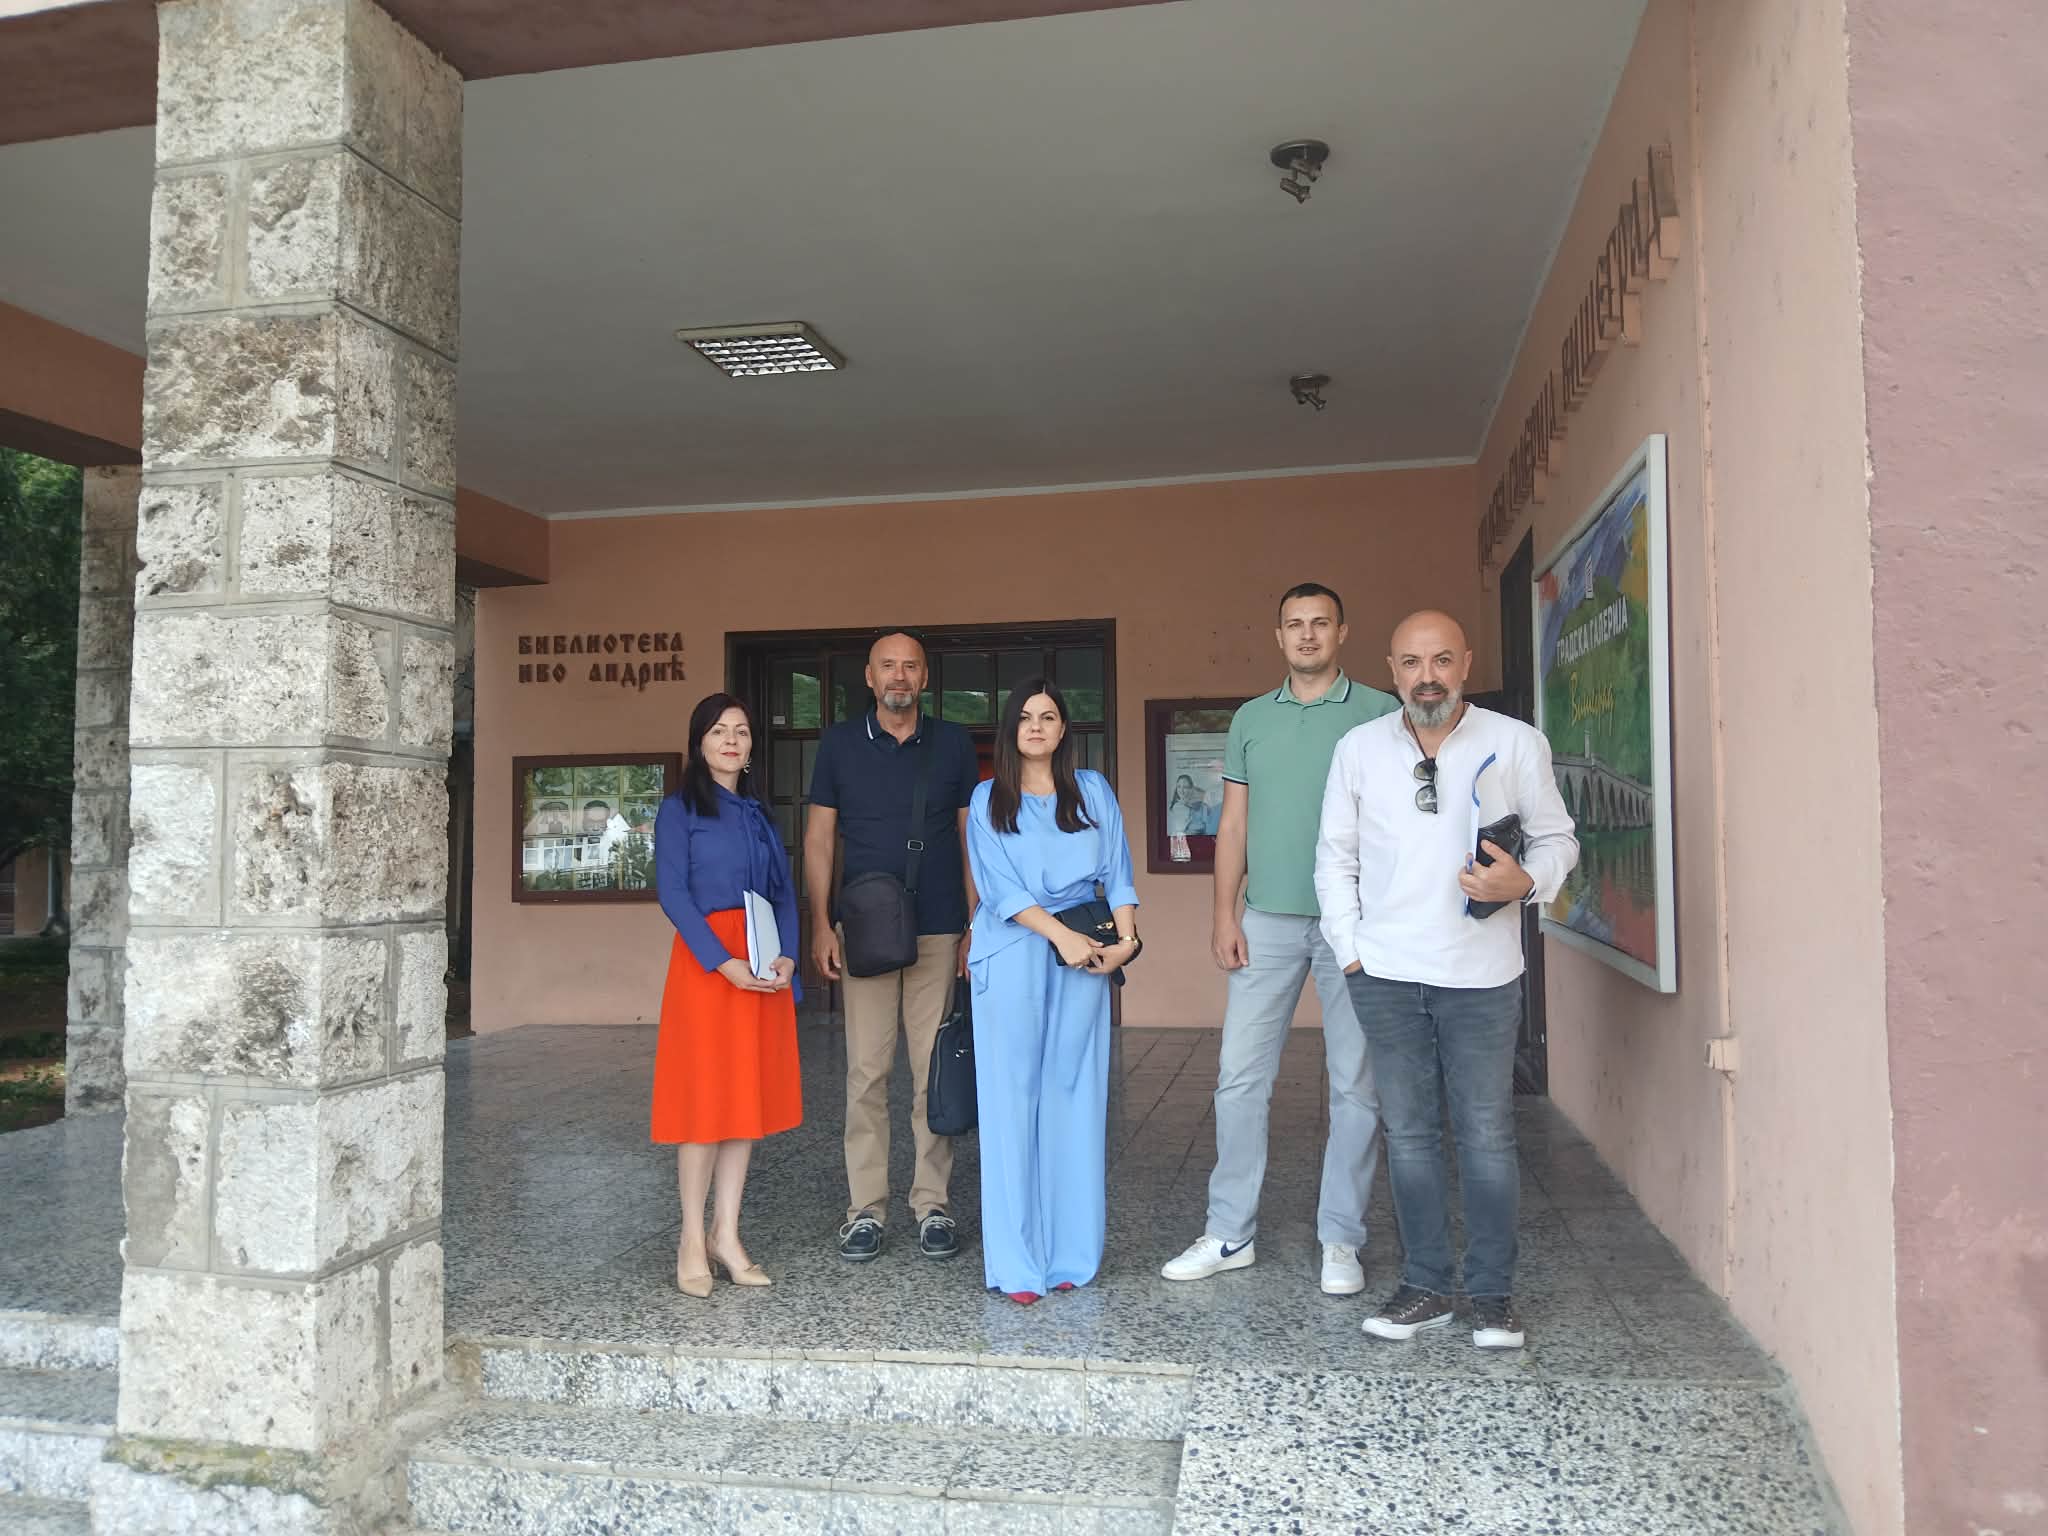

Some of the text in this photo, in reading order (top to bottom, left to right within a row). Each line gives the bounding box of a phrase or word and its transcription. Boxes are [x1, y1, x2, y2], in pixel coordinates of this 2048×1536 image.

[518, 632, 684, 655] БИБЛИОТЕКА
[1556, 593, 1629, 667] ГРАДСКА ГАЛЕРИЈА
[518, 654, 686, 692] ИВО АНДРИЋ
